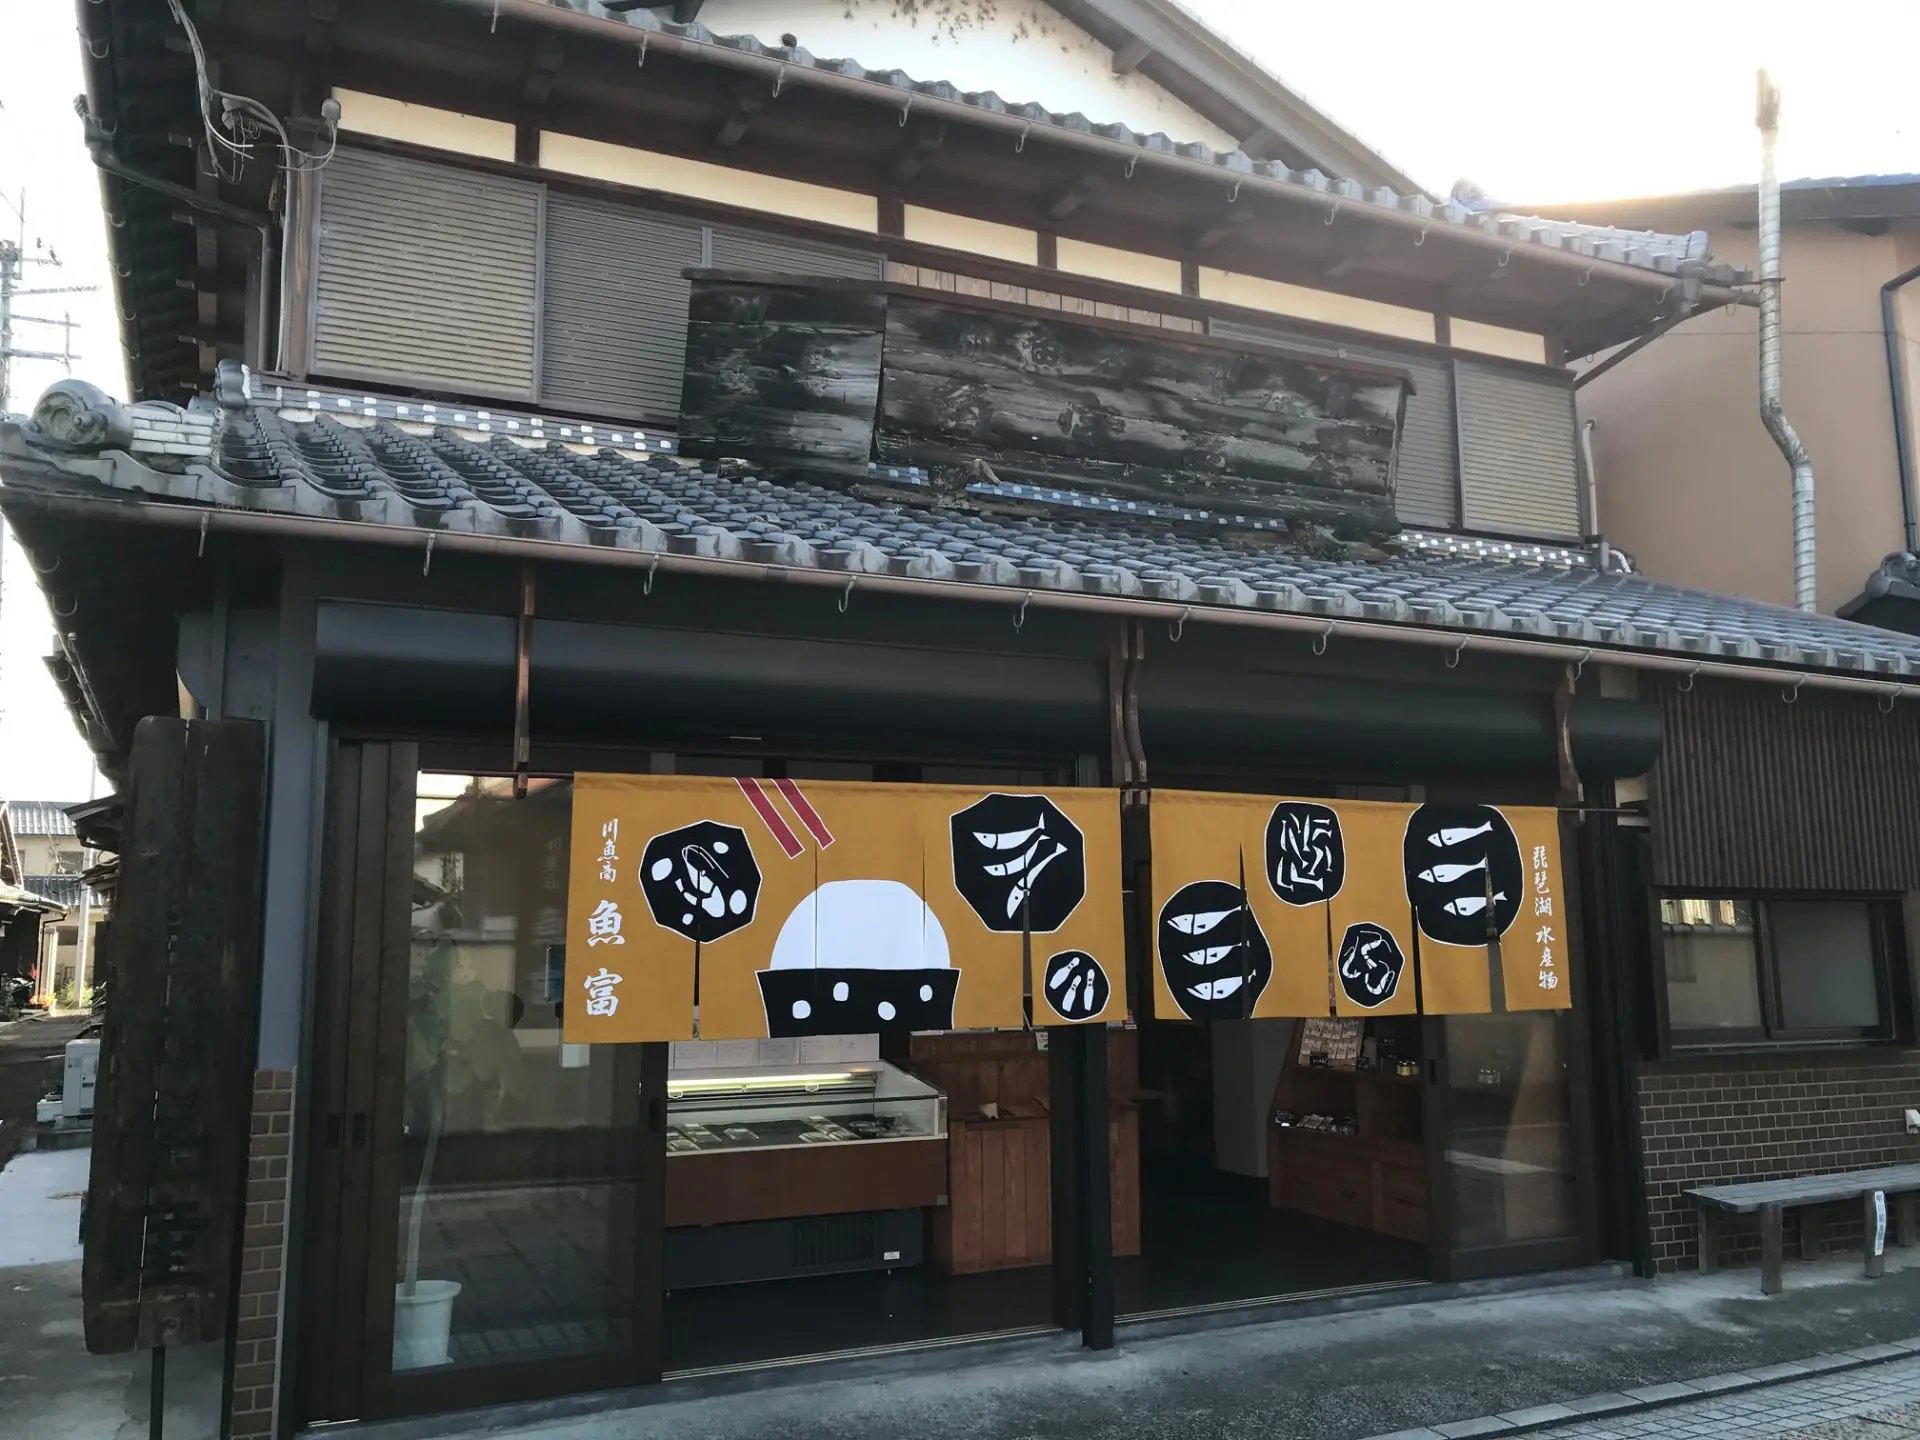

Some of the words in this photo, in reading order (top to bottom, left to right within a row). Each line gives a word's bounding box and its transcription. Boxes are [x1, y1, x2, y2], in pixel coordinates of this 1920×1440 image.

[596, 817, 620, 883] 川魚商
[584, 899, 625, 1017] 魚富
